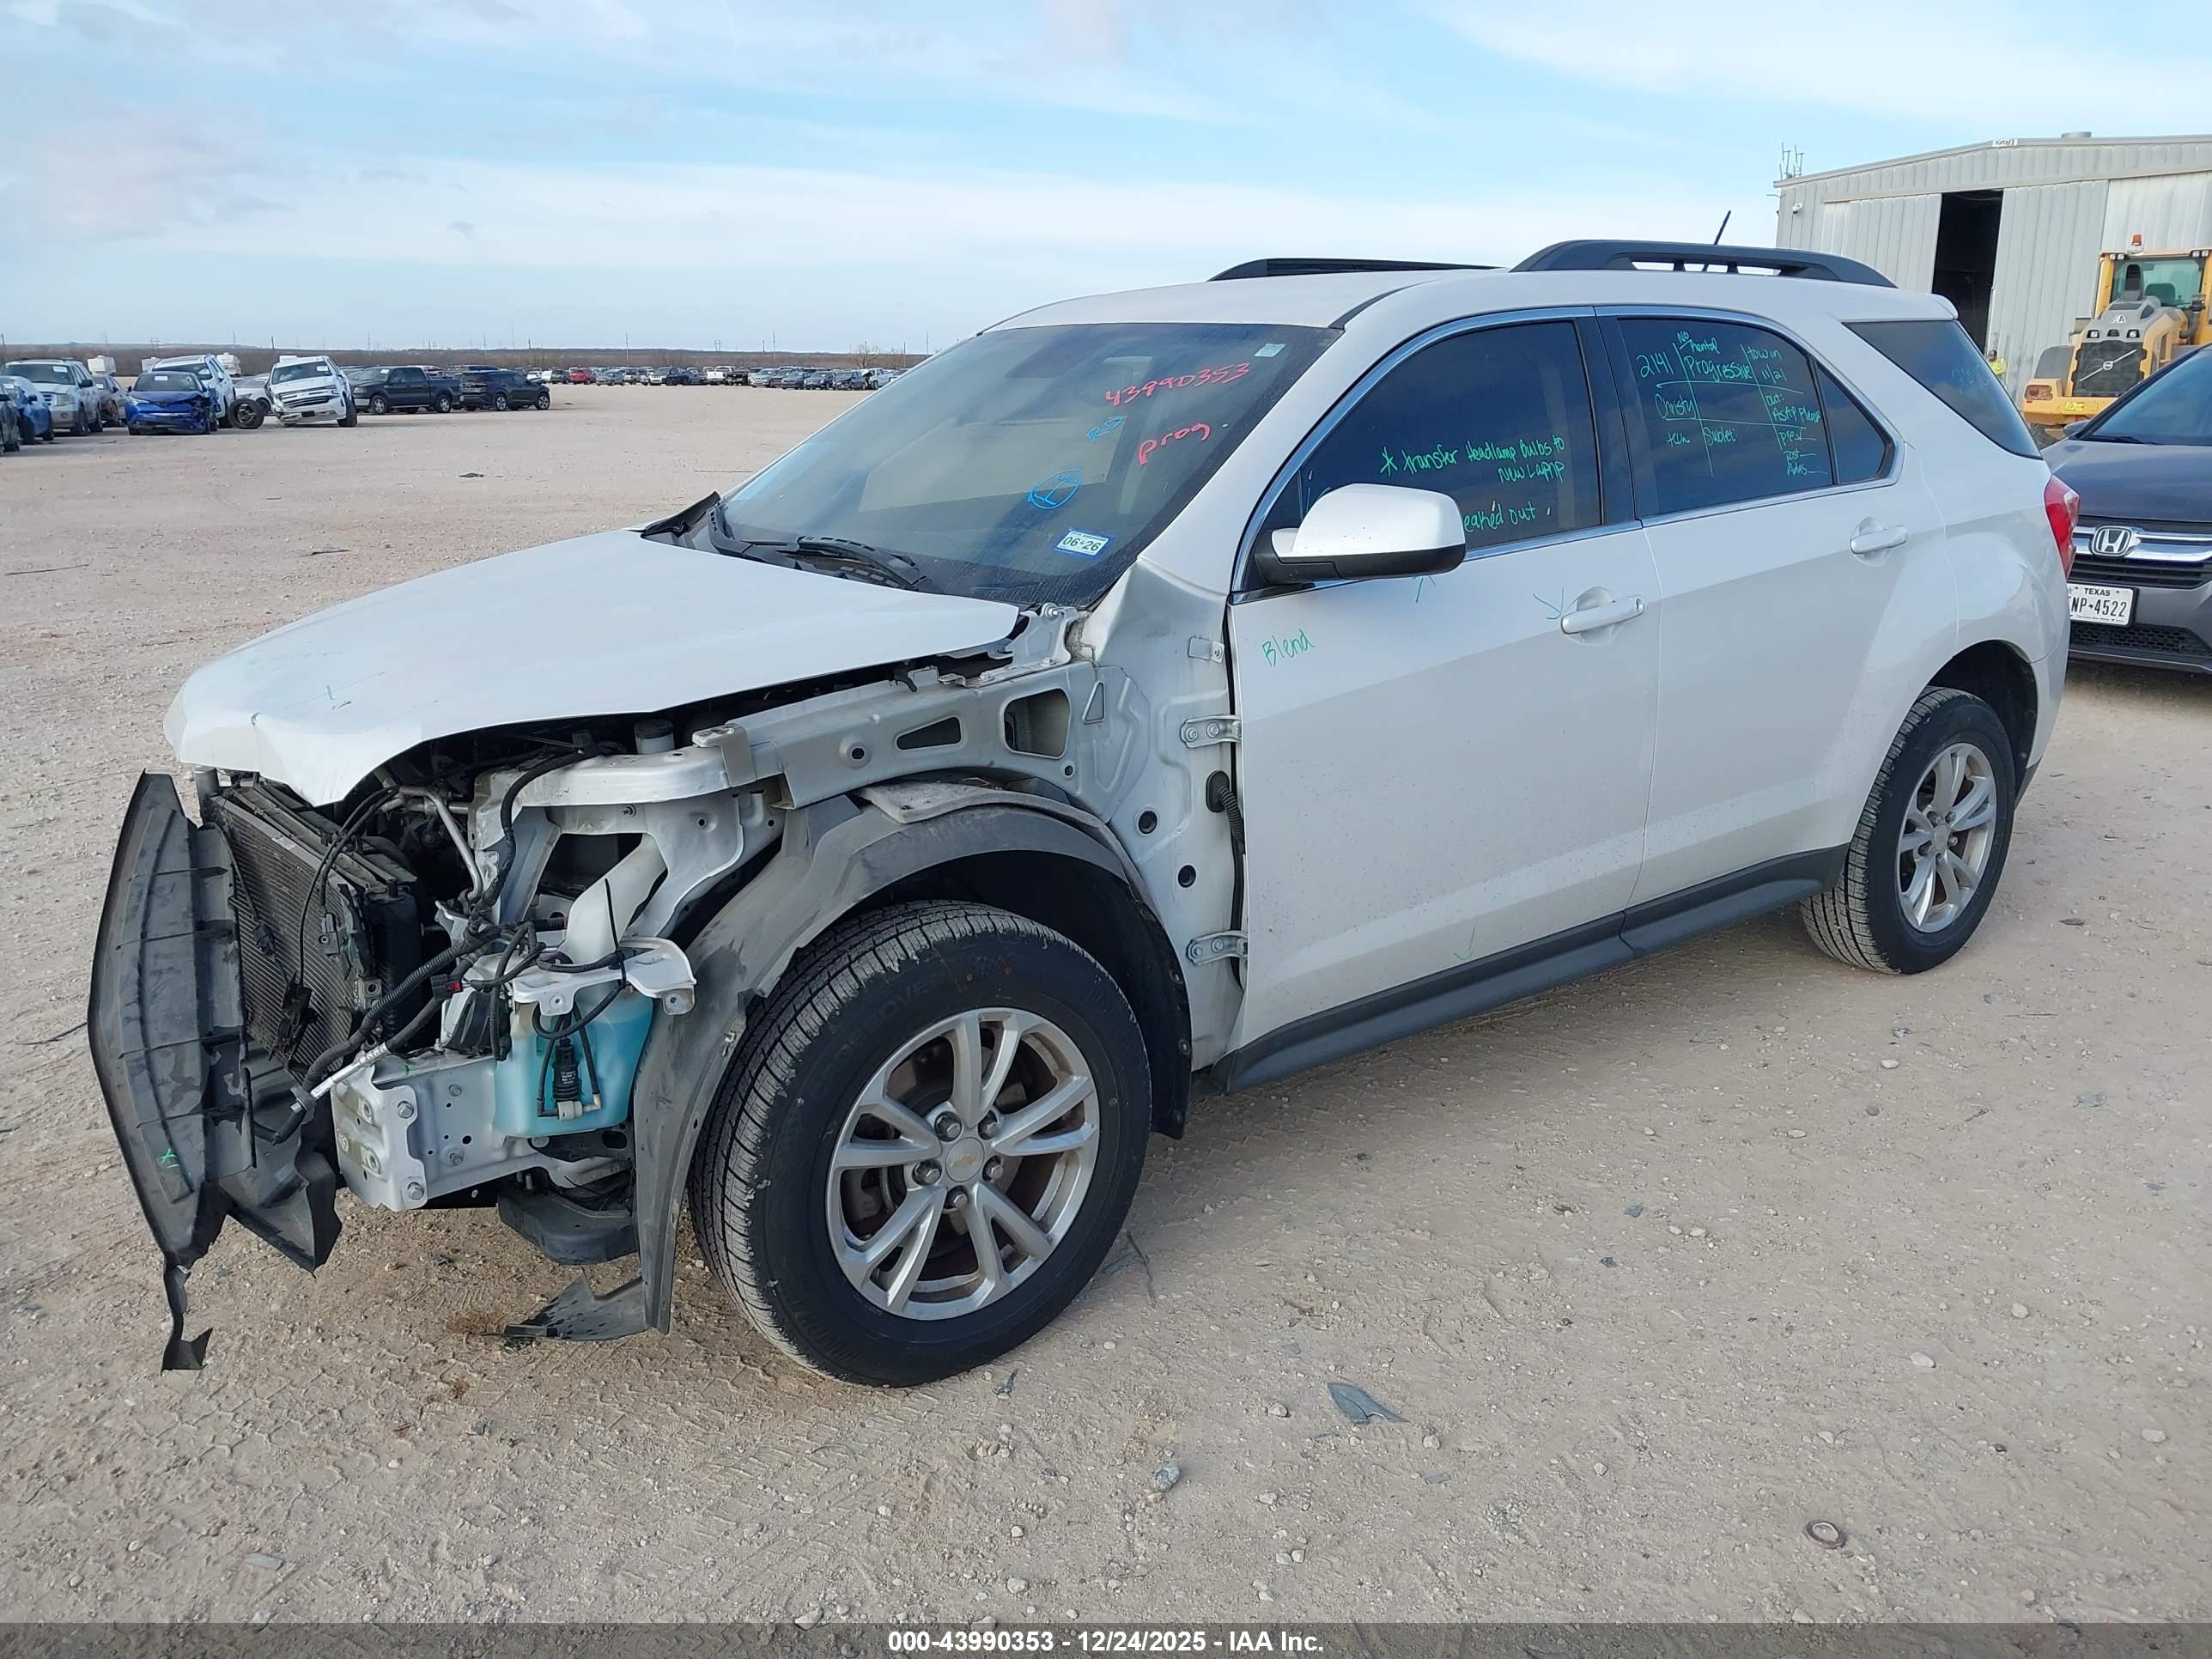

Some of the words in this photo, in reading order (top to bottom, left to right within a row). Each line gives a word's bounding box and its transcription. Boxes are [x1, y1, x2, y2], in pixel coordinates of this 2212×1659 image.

[1637, 351, 1674, 377] 2141
[1105, 362, 1251, 406] 43990353
[2083, 587, 2111, 597] TEXAS
